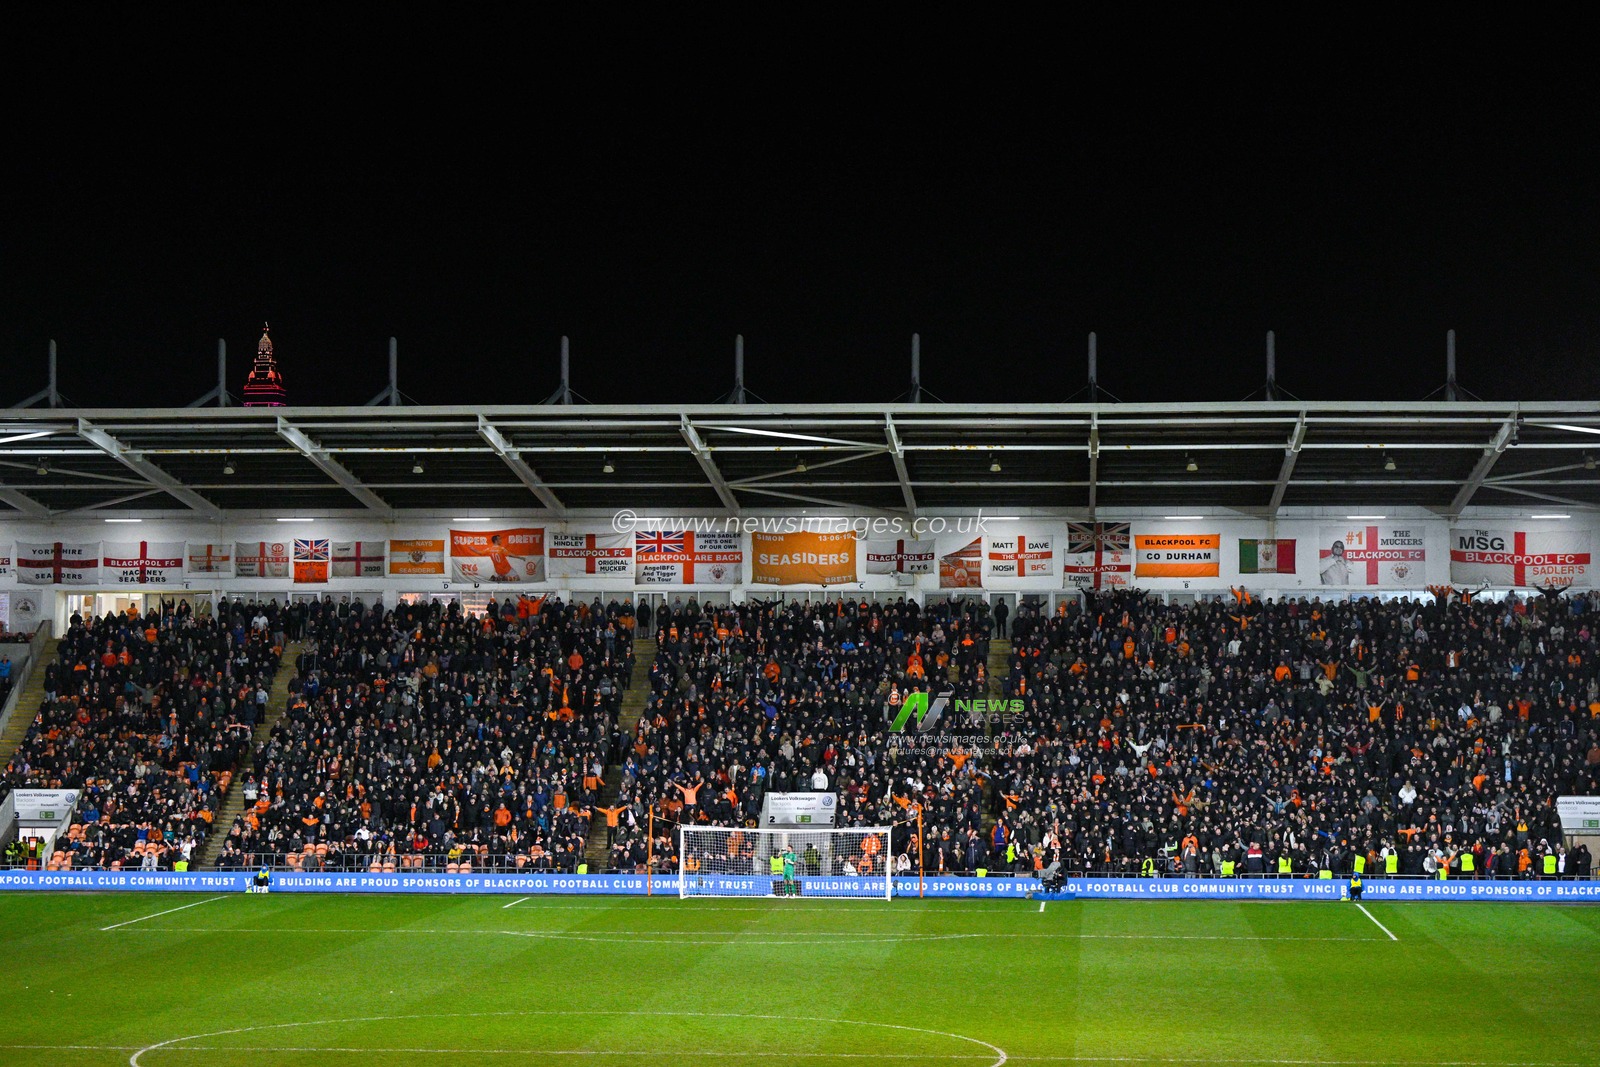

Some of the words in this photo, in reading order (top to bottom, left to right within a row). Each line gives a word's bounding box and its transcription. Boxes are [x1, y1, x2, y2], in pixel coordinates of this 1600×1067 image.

[454, 536, 487, 545] SUPER
[508, 535, 541, 544] BRETT
[1346, 531, 1362, 545] #1
[1460, 537, 1504, 550] MSG
[492, 553, 500, 562] 10
[759, 552, 849, 565] SEASIDERS
[1466, 553, 1552, 565] BLACKPOOL
[1557, 555, 1575, 564] FC
[1533, 566, 1584, 575] SADLER'S
[1544, 577, 1574, 585] ARMY
[39, 876, 94, 885] FOOTBALL
[99, 876, 126, 885] CLUB
[137, 877, 197, 885] COMMUNITY
[280, 878, 331, 886] BUILDING
[362, 878, 399, 886] PROUD
[403, 879, 461, 887] SPONSORS
[484, 880, 548, 888] BLACKPOOL
[553, 880, 608, 888] FOOTBALL
[614, 880, 642, 888] CLUB
[806, 882, 860, 890] BUILDING
[933, 883, 992, 891] SPONSORS
[1087, 884, 1144, 892] FOOTBALL
[1183, 884, 1253, 892] COMMUNITY
[1341, 885, 1395, 893] BDING
[1427, 886, 1466, 894] PROUD
[1471, 886, 1532, 894] SPONSORS
